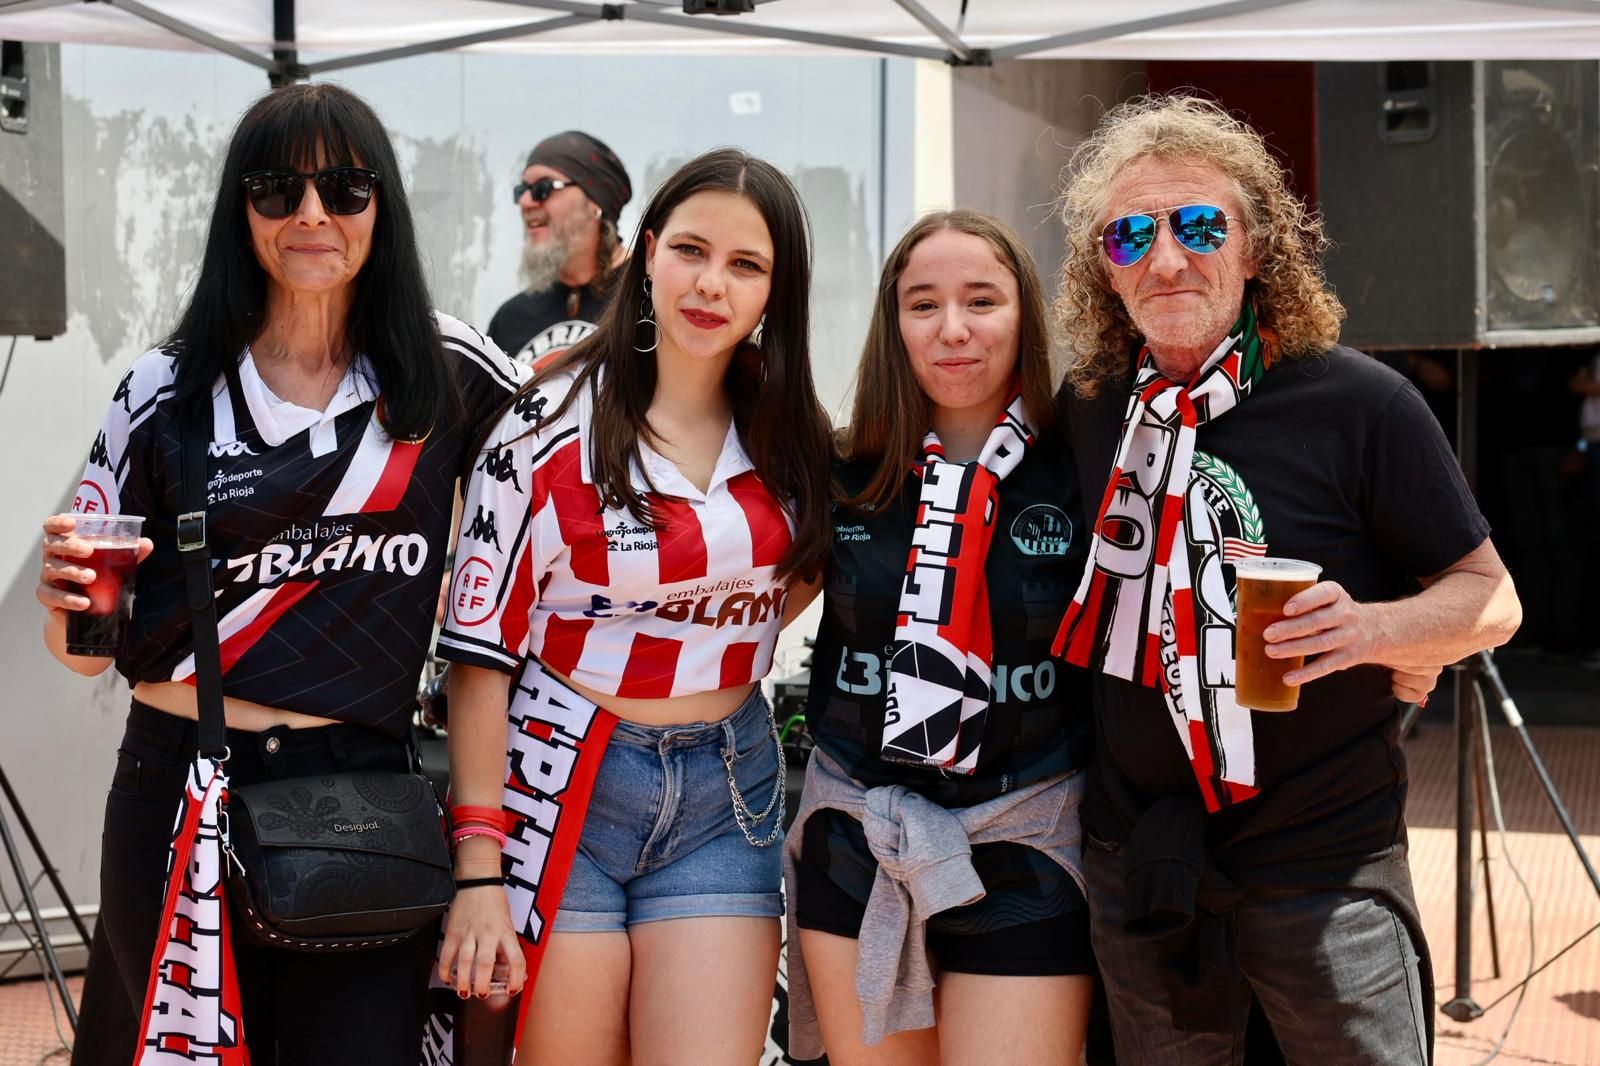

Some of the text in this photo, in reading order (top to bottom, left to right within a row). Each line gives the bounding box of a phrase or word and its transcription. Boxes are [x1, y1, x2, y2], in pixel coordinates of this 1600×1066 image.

[218, 486, 255, 501] La Rioja
[270, 522, 354, 541] mbalajes
[834, 525, 865, 533] obierno
[851, 532, 871, 541] Rioja
[621, 540, 660, 551] La Rioja
[258, 533, 429, 584] BLANCO
[667, 577, 754, 601] embalajes
[655, 587, 790, 629] BLAN
